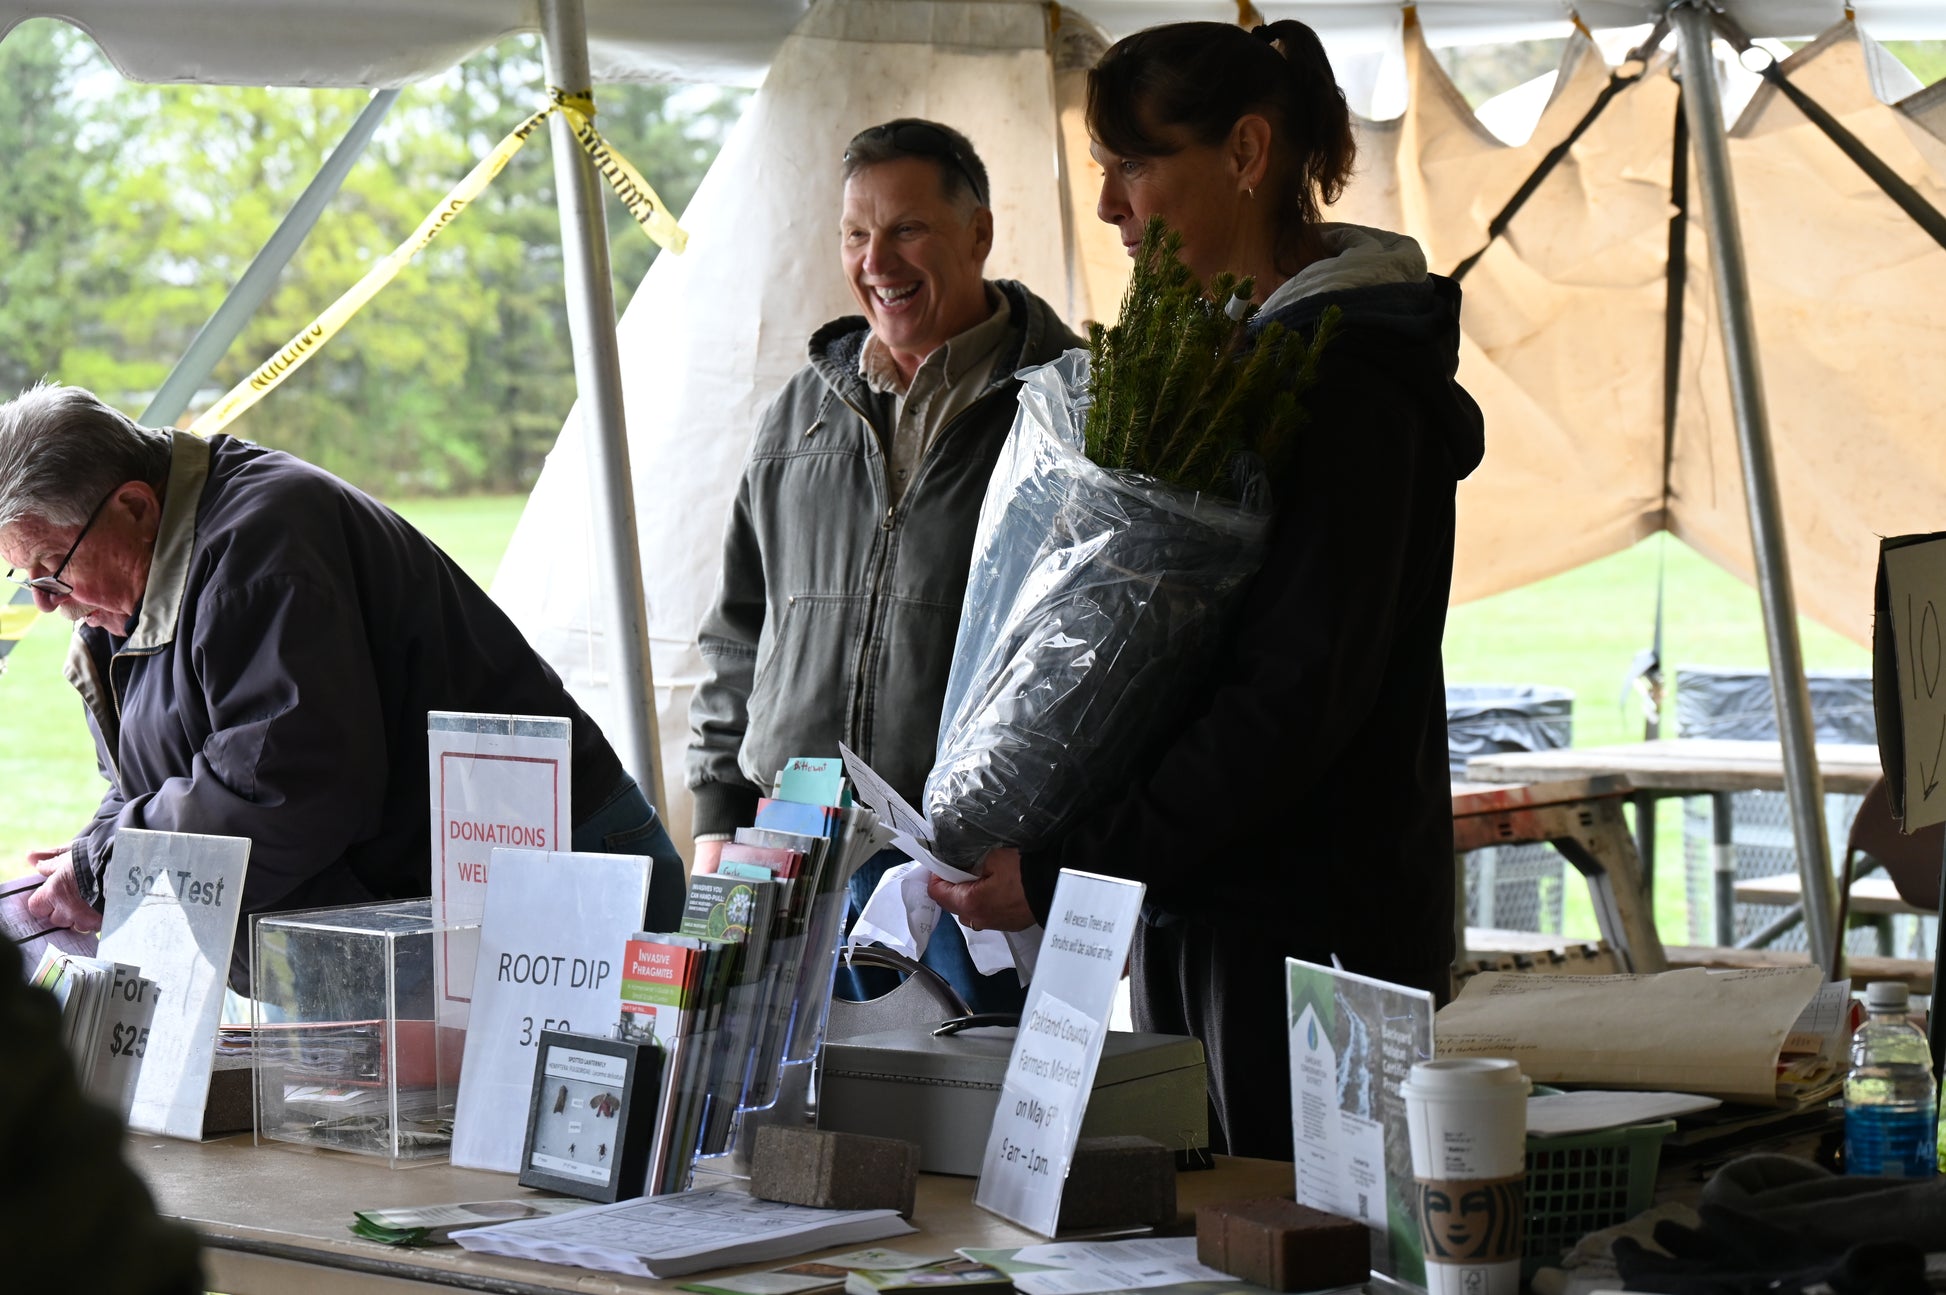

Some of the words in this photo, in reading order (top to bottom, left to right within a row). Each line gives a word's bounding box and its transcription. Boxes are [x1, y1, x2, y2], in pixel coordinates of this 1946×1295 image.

[450, 820, 546, 847] DONATIONS
[458, 862, 487, 883] WEL
[176, 871, 225, 907] Test
[1063, 910, 1073, 924] All
[1072, 915, 1088, 928] excess
[1088, 914, 1103, 931] Trees
[1102, 921, 1115, 933] and
[639, 948, 671, 965] INVASIVE
[1050, 934, 1069, 951] Shrubs
[1068, 938, 1079, 953] will
[1077, 939, 1085, 955] be
[1103, 945, 1113, 960] the
[498, 953, 565, 986] ROOT
[571, 958, 610, 989] DIP
[632, 961, 673, 979] PHRAGMITES
[111, 969, 149, 1003] For
[110, 1021, 151, 1060] $25
[1029, 1010, 1062, 1039] Oakland
[1062, 1018, 1091, 1049] County
[1018, 1050, 1049, 1080] Farmers
[1051, 1059, 1081, 1088] Market
[1015, 1099, 1027, 1118] on
[1027, 1100, 1046, 1129] May
